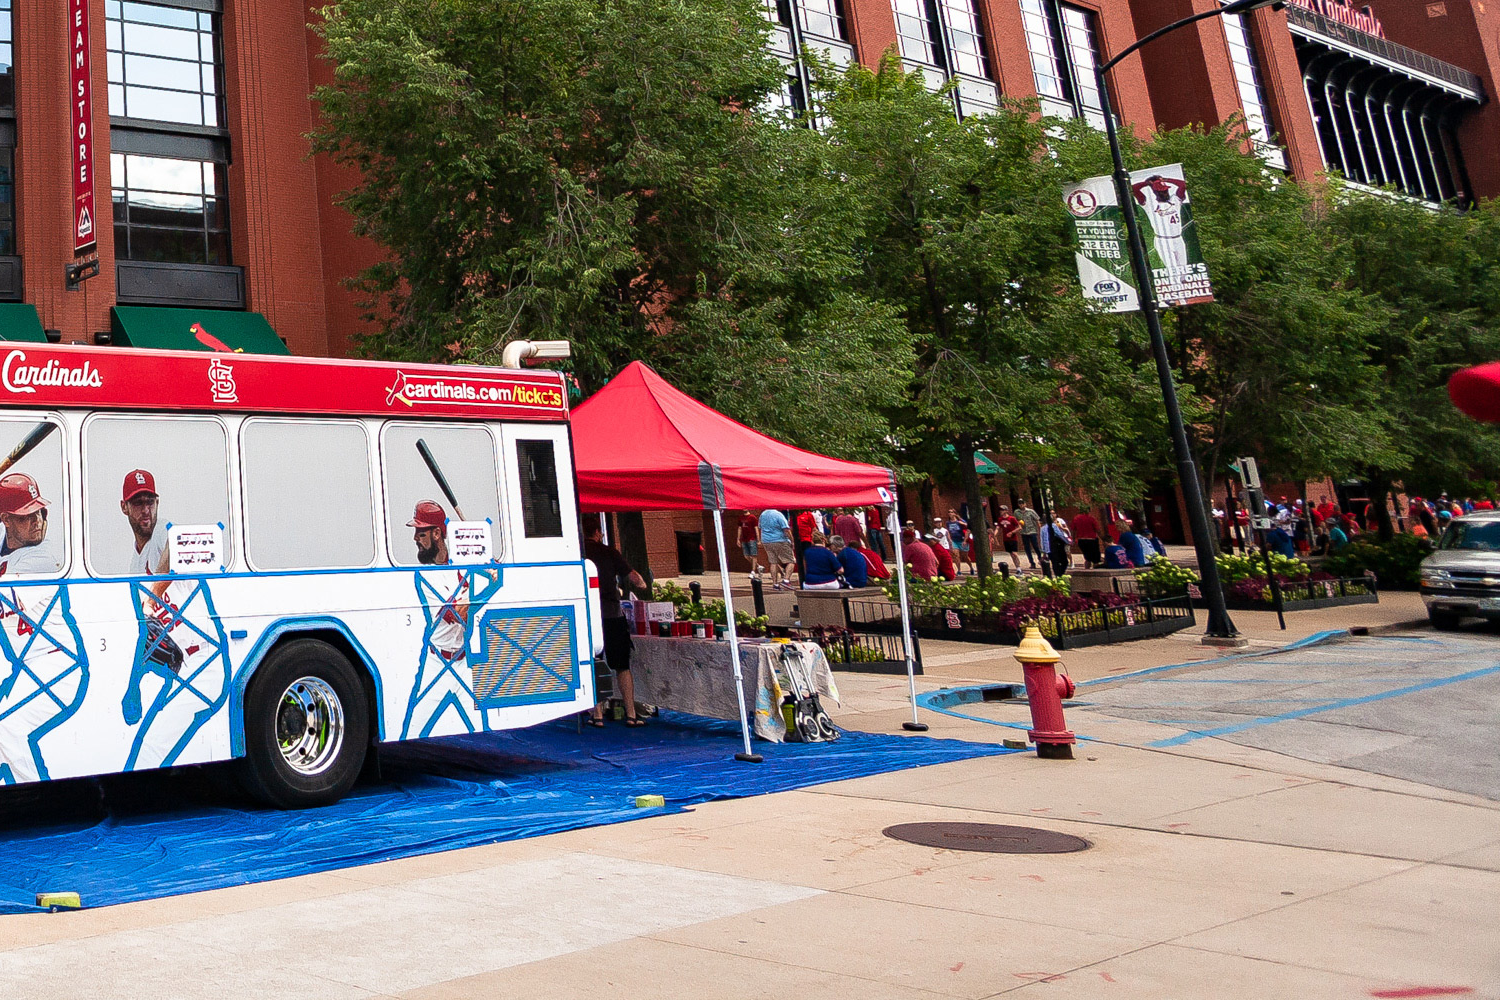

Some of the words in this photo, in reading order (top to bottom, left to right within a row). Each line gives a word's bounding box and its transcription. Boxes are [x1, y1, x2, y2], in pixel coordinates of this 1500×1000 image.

[77, 79, 88, 184] STORE
[1077, 227, 1088, 235] CY
[1099, 241, 1118, 250] ERA
[1095, 250, 1121, 259] 1968
[1152, 263, 1207, 278] THERE'S
[1185, 272, 1209, 283] ONE
[1155, 280, 1211, 294] CARDINALS
[1157, 287, 1213, 302] BASEBALL
[1, 349, 103, 393] Cardinals
[100, 638, 107, 652] 3
